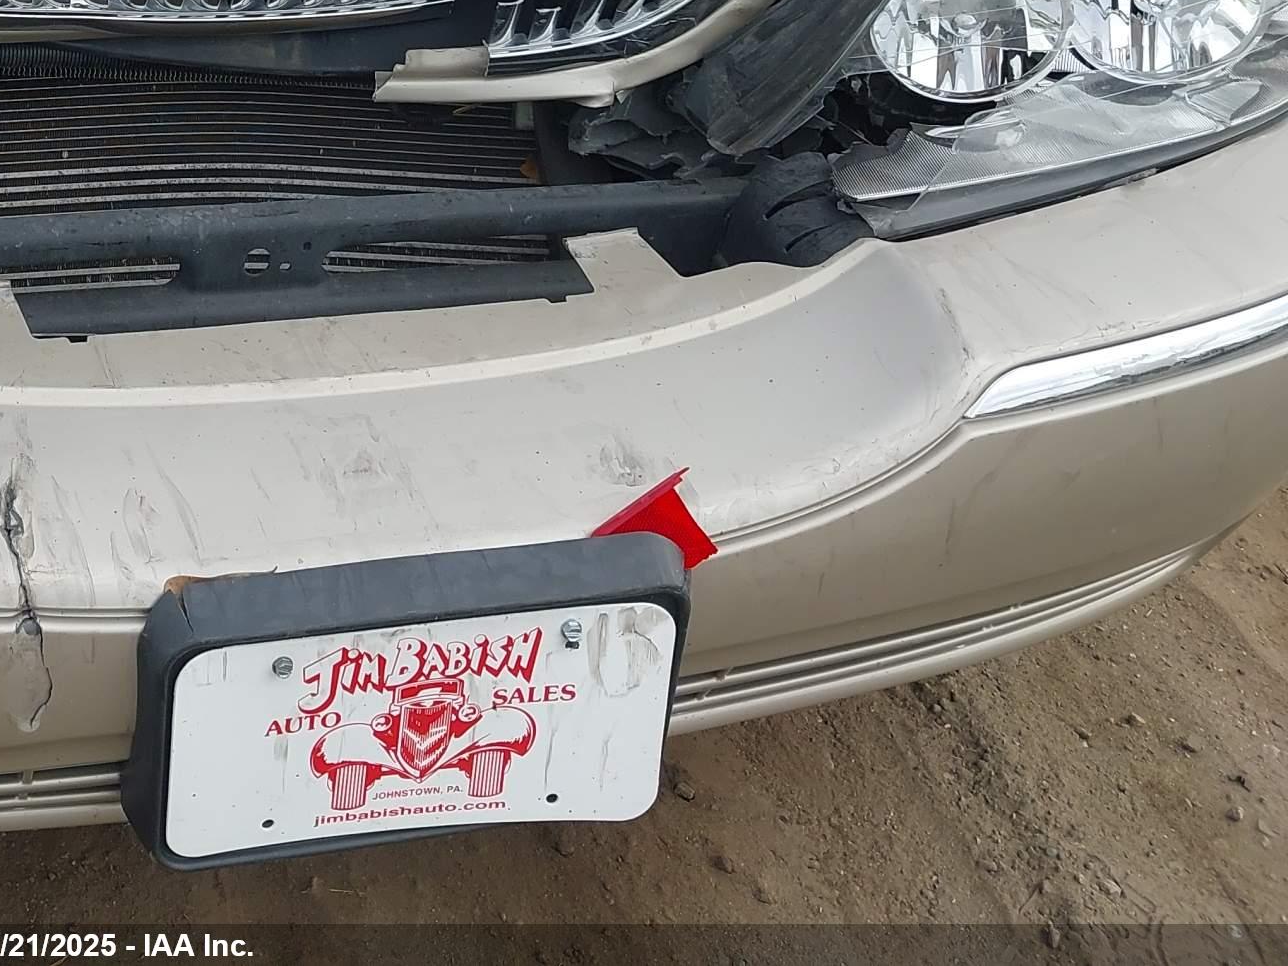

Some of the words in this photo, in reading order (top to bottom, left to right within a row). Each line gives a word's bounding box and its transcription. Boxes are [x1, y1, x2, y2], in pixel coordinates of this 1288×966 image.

[265, 711, 342, 738] AUTO
[492, 683, 577, 705] SALES
[372, 786, 443, 801] JOHNSTOWN,
[313, 800, 507, 828] jimbabishauto.com
